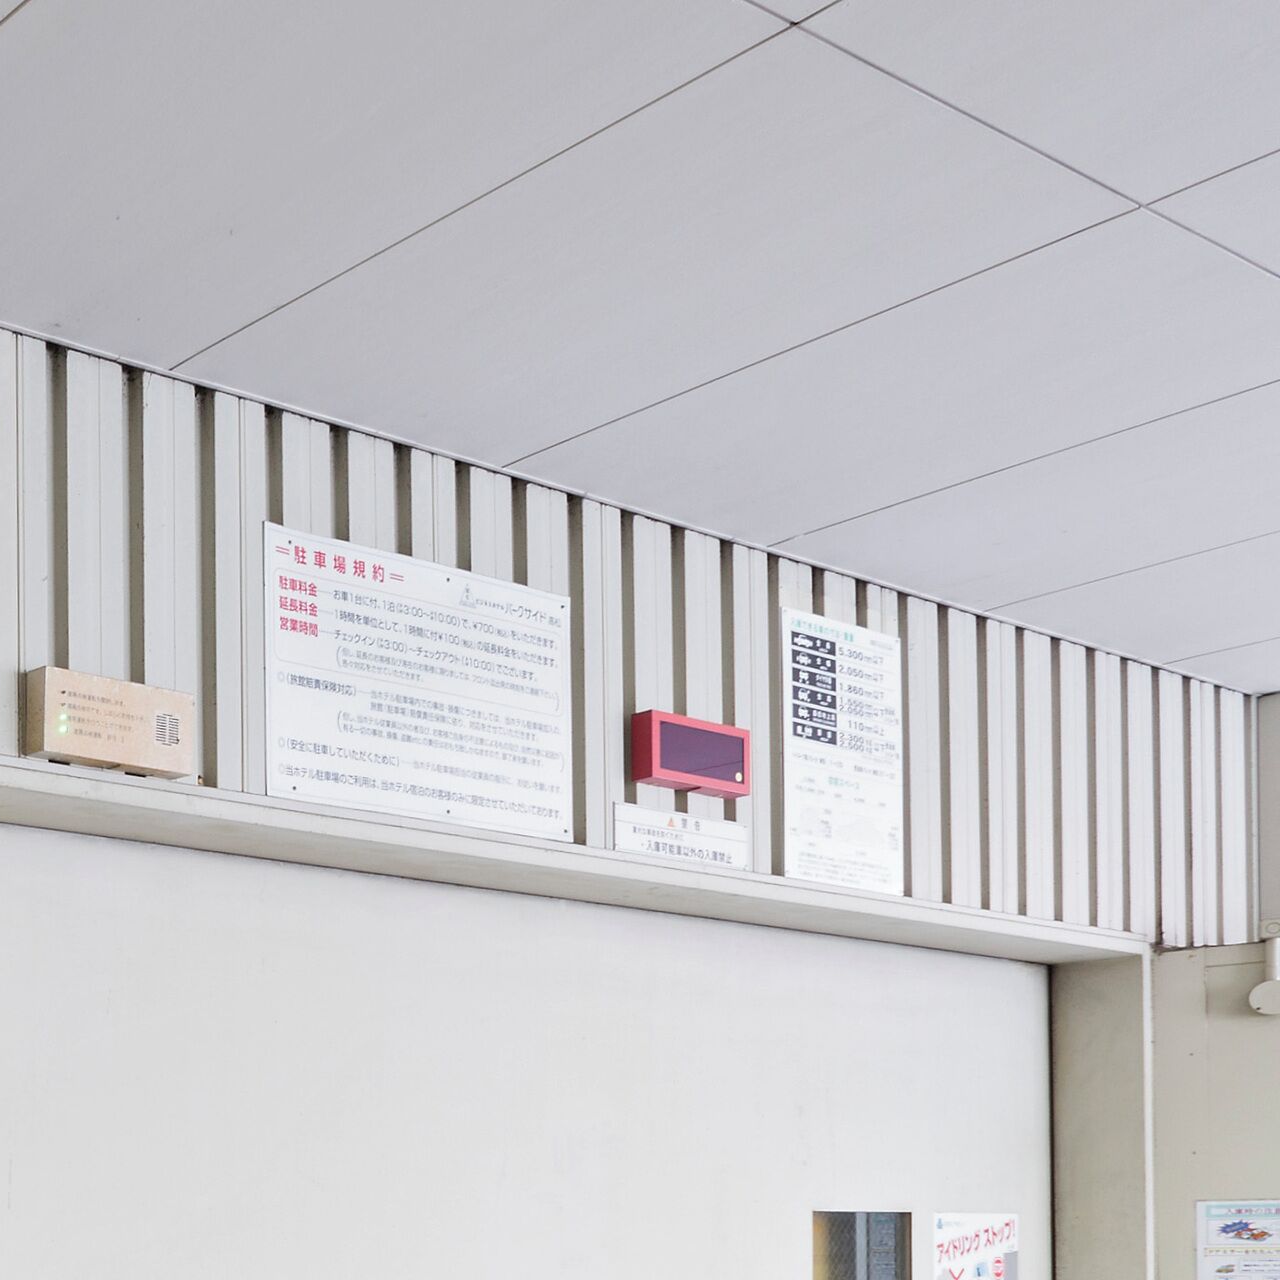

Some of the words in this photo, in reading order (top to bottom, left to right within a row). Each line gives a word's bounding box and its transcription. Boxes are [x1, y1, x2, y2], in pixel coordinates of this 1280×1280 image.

[294, 546, 385, 582] 駐車場規約
[278, 575, 317, 597] 駐車料金
[279, 595, 318, 617] 延長料金
[279, 615, 318, 637] 営業時間
[936, 1230, 980, 1263] アイドリング
